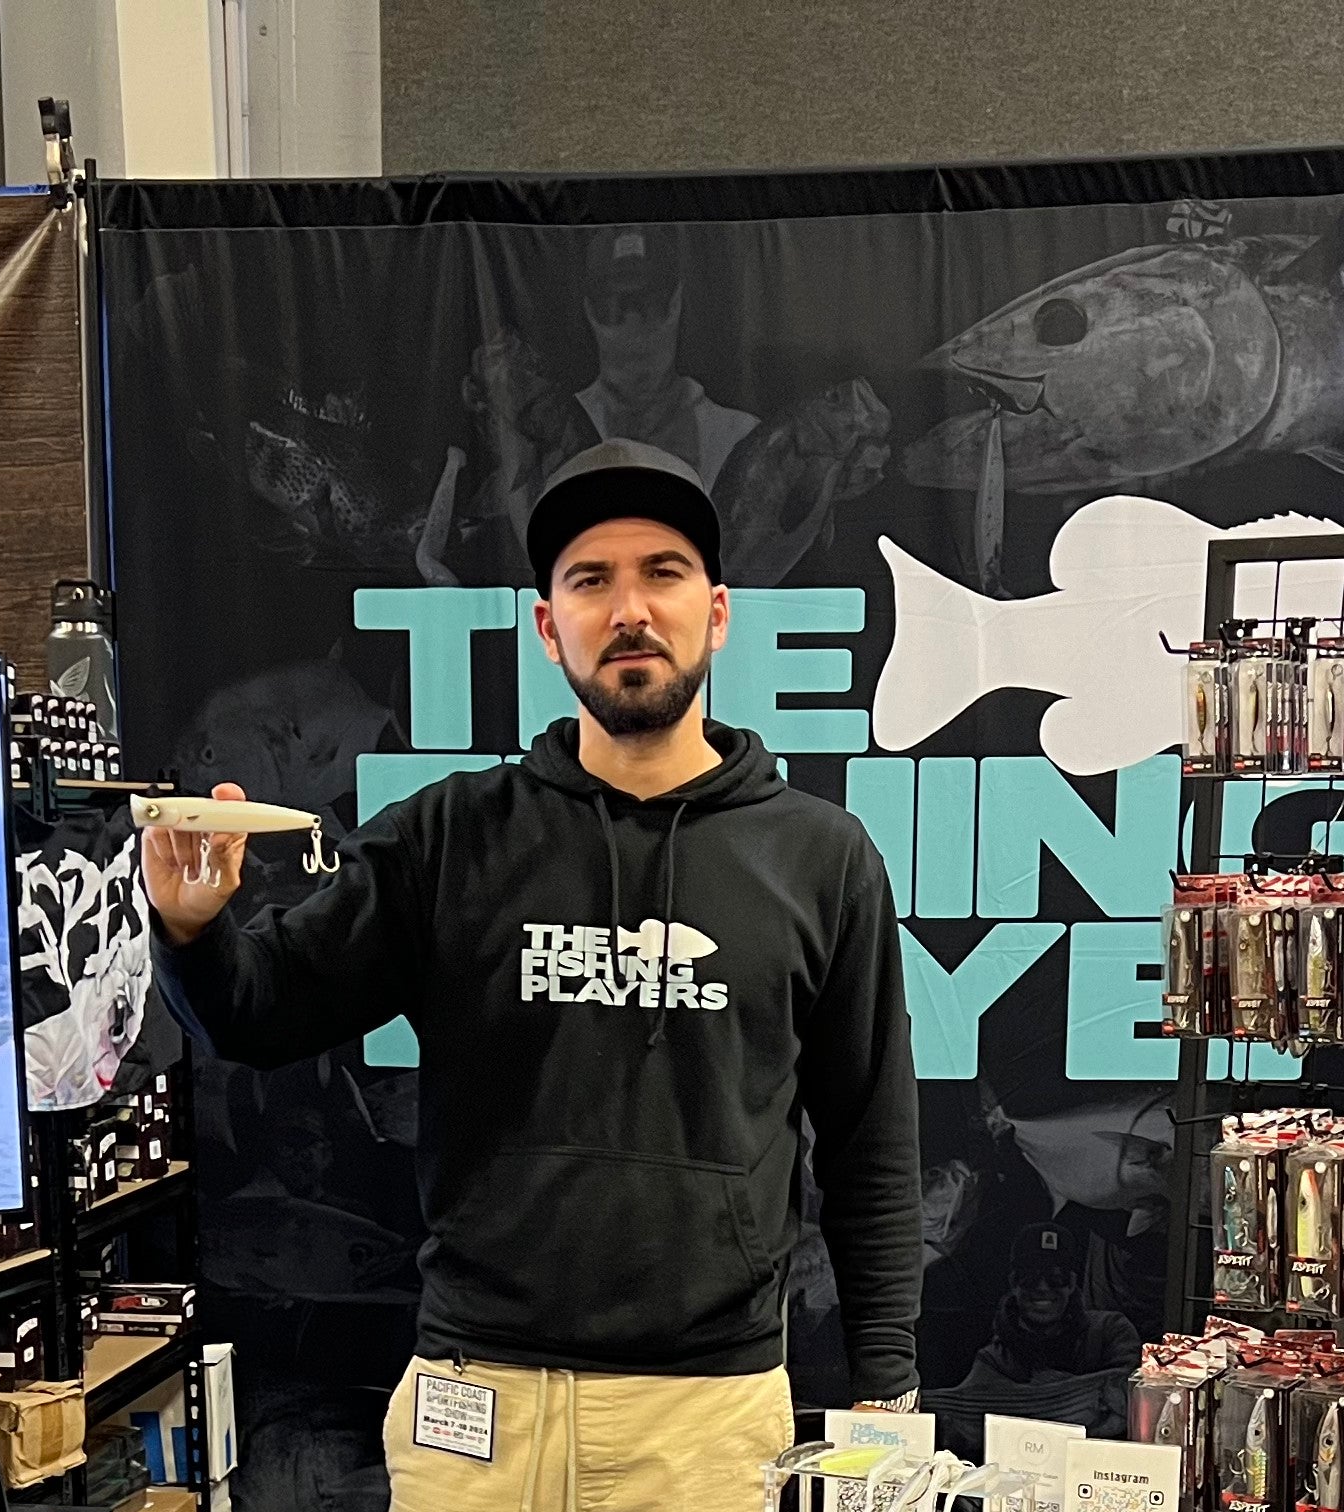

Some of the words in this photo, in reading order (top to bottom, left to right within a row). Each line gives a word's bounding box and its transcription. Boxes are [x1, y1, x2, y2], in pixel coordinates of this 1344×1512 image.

[522, 923, 612, 955] THE
[521, 974, 729, 1011] PLAYERS
[461, 1386, 488, 1402] COAST
[1024, 1442, 1045, 1454] RM
[1093, 1470, 1150, 1485] Instagram
